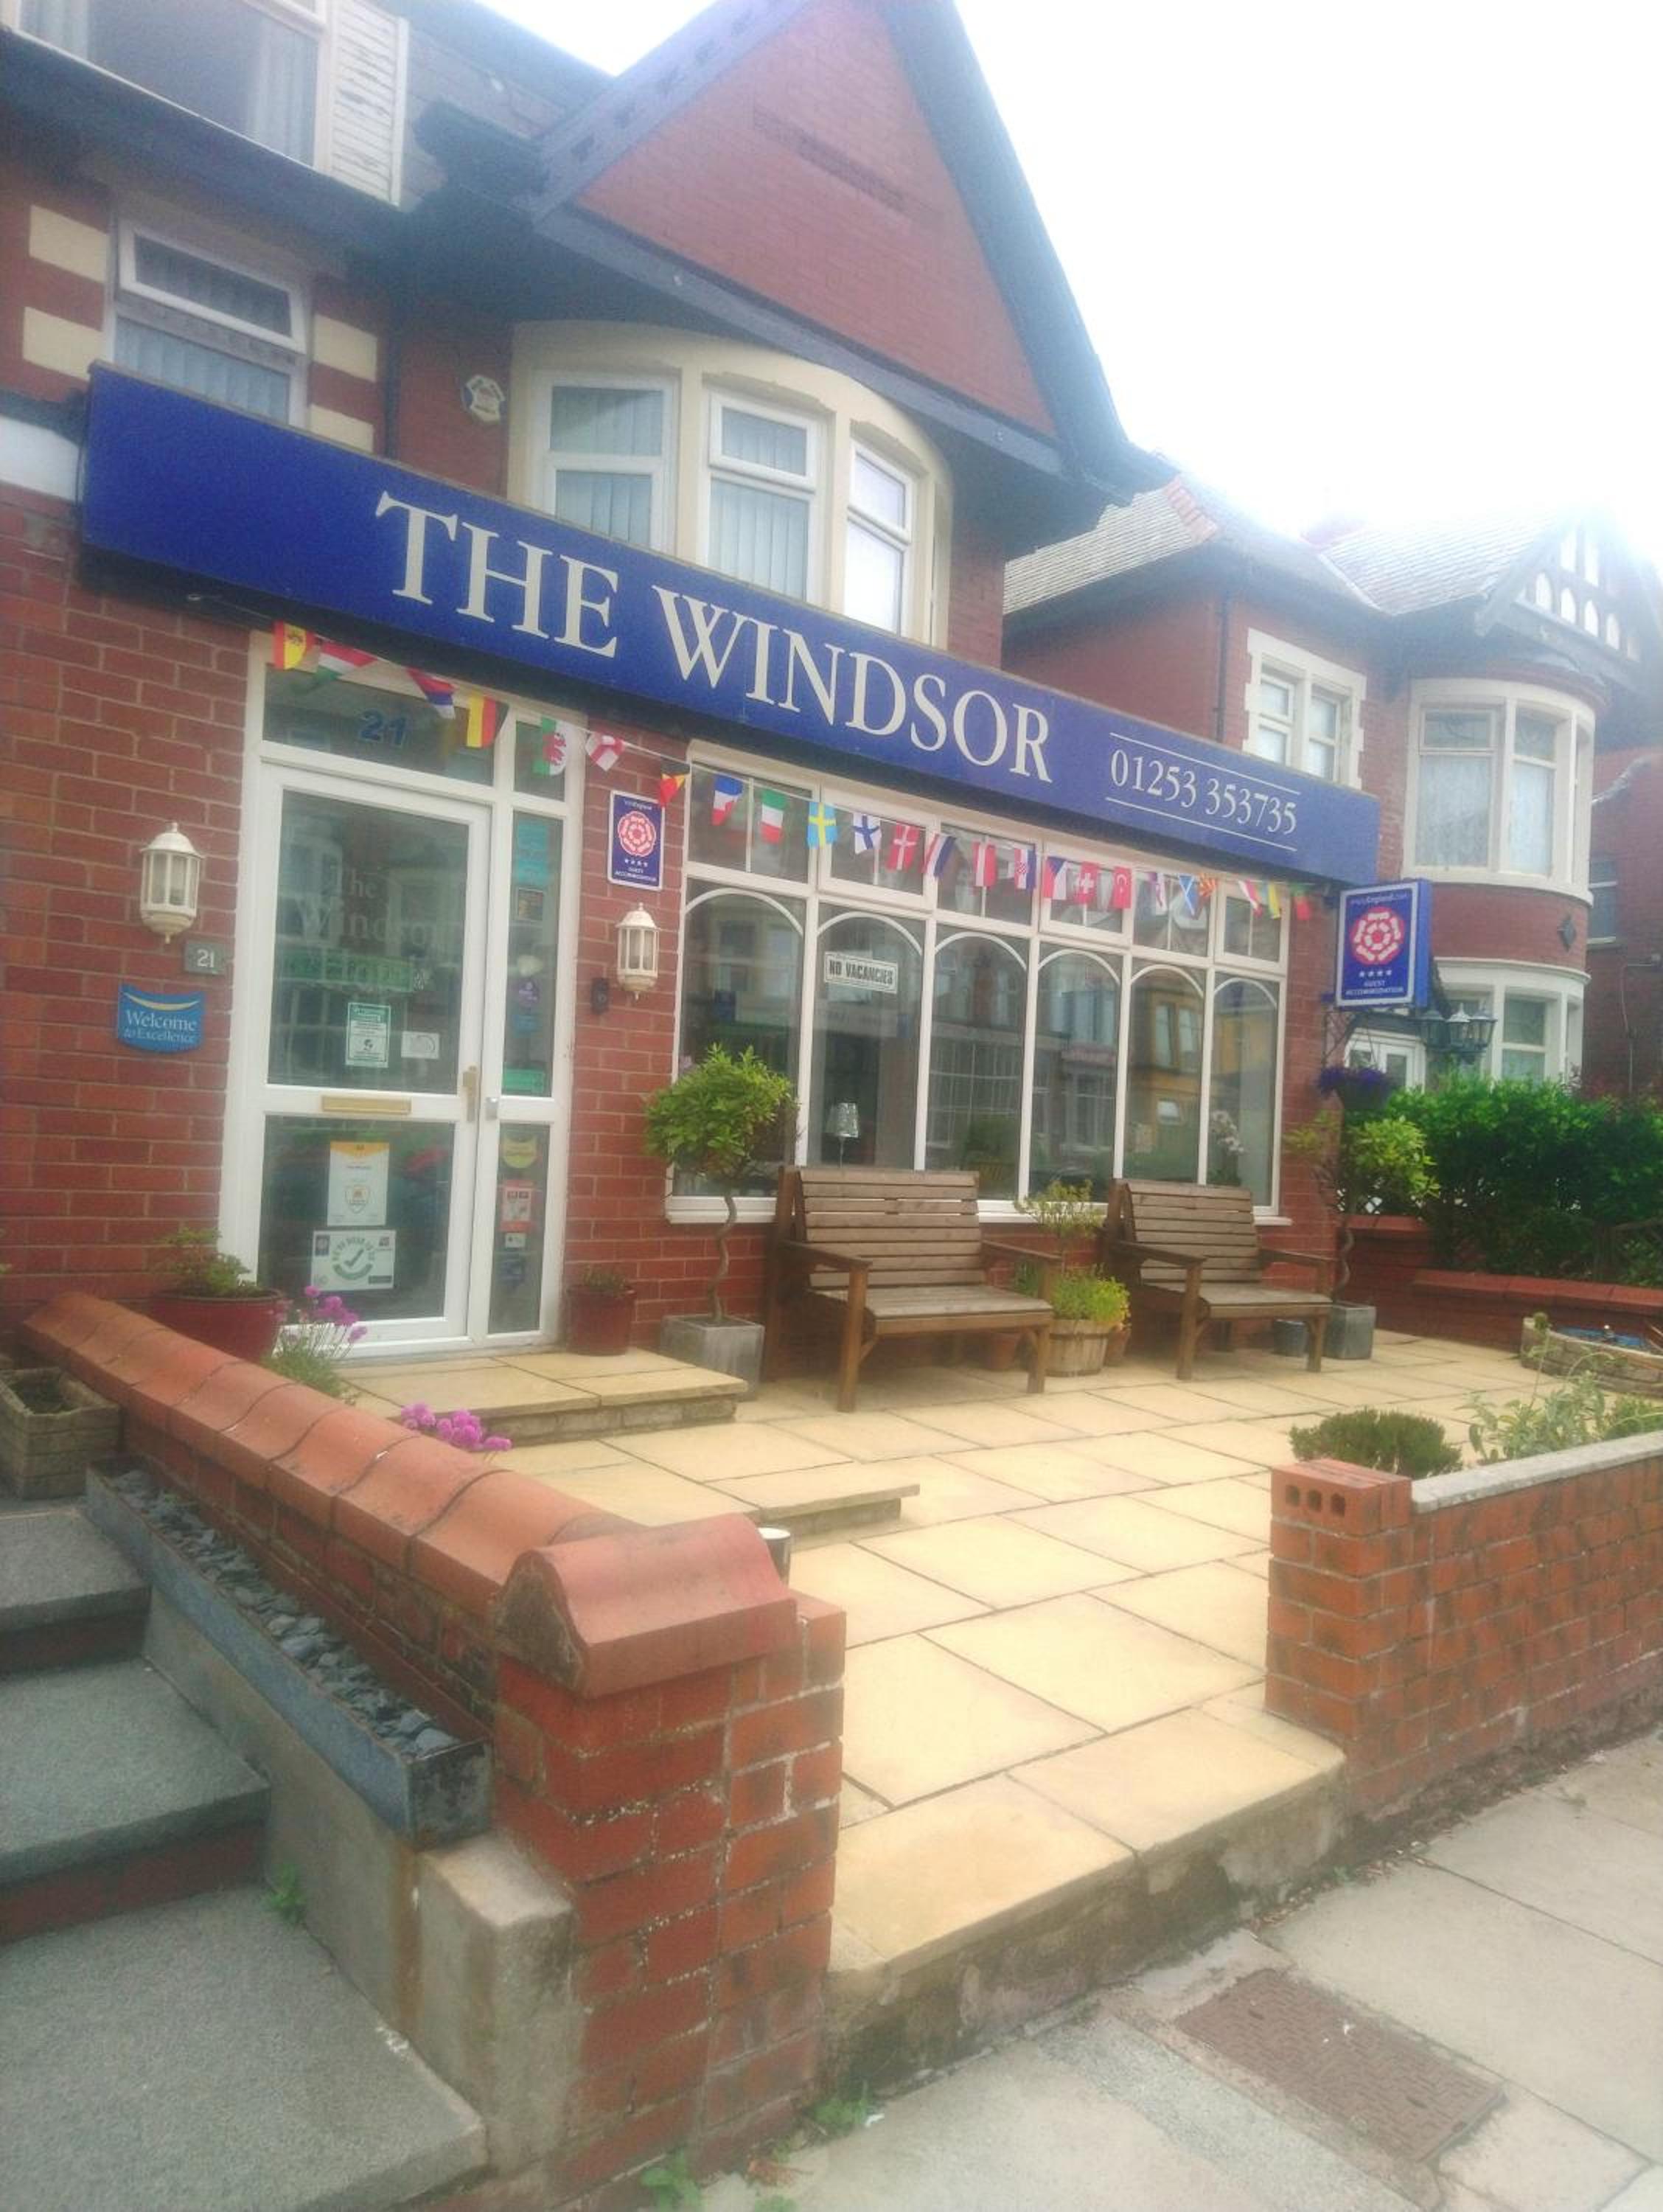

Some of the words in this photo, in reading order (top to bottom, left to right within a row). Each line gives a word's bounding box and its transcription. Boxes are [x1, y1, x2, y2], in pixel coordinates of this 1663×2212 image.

[376, 490, 619, 658] THE
[652, 584, 1053, 784] WINDSOR
[359, 709, 407, 745] 21
[1110, 748, 1197, 809] 01253
[1204, 777, 1297, 835] 353735
[197, 948, 215, 968] 21
[829, 960, 843, 975] NO
[846, 961, 893, 985] VACANCIES
[125, 1009, 198, 1031] Welcome
